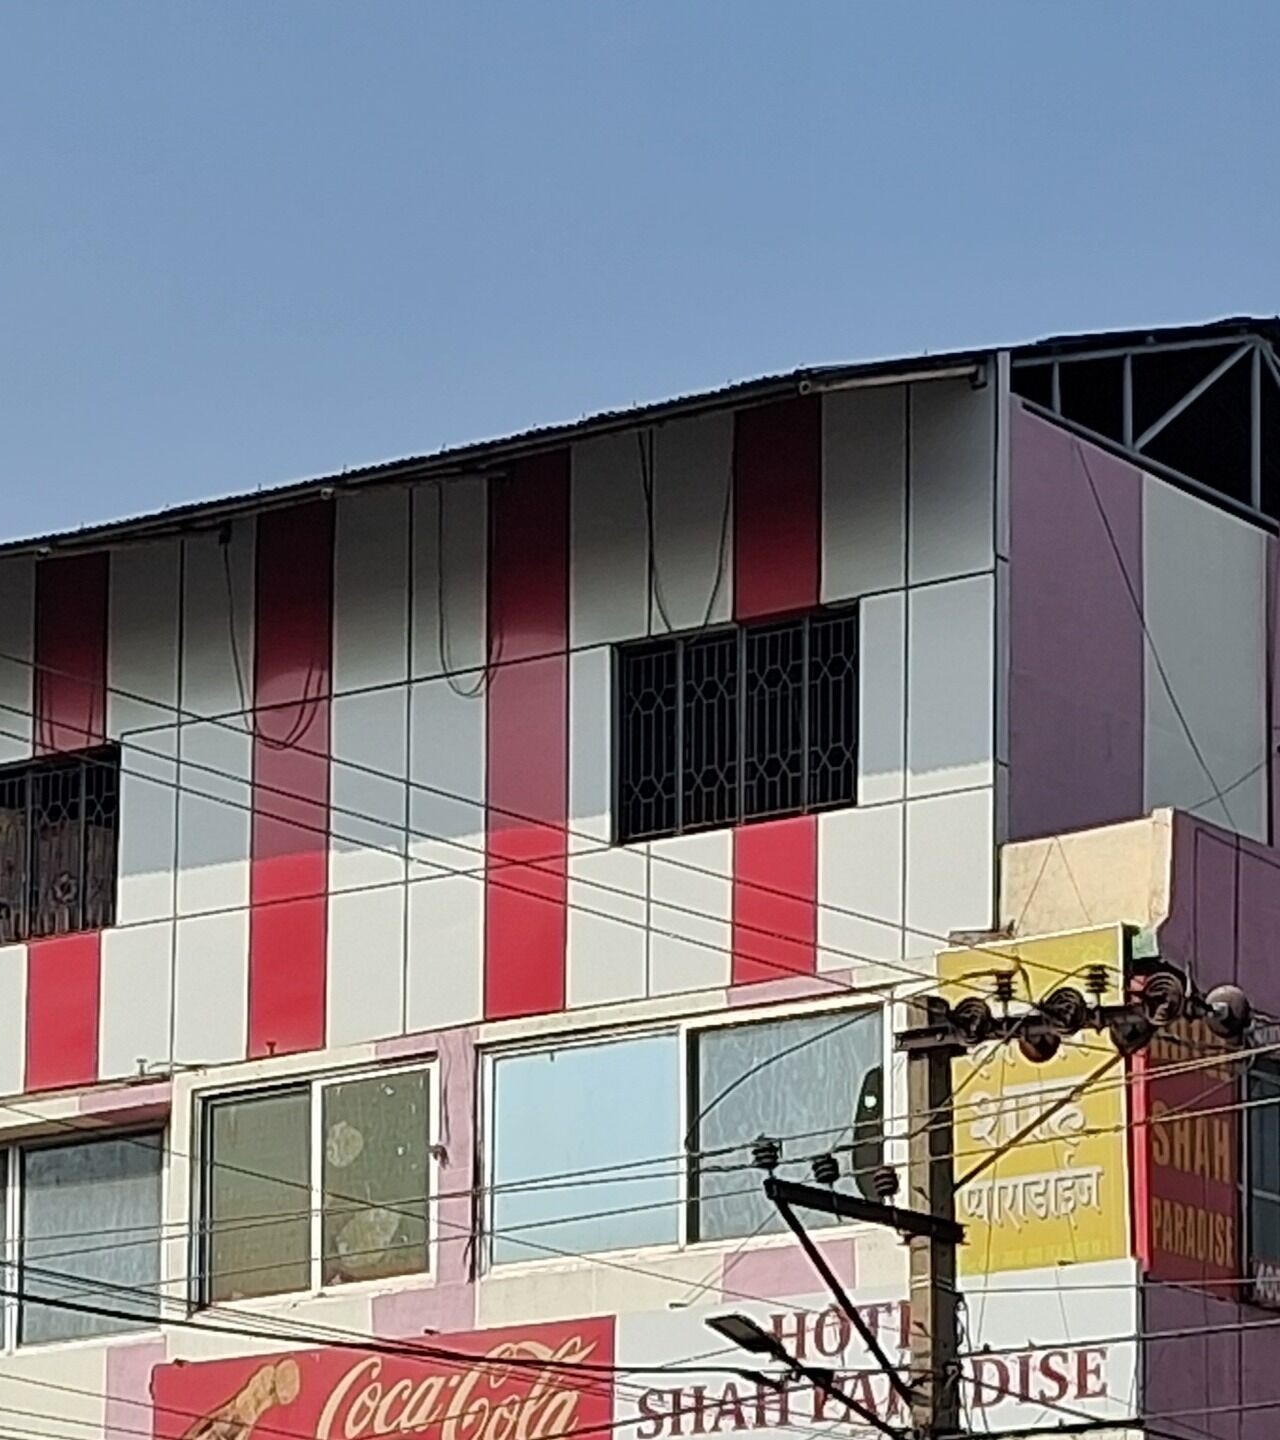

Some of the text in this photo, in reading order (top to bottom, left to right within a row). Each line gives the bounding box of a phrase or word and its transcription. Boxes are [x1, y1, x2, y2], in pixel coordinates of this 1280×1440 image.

[1152, 1100, 1231, 1184] SHAH
[1152, 1196, 1236, 1269] PARADISE
[637, 1379, 788, 1440] SHAH
